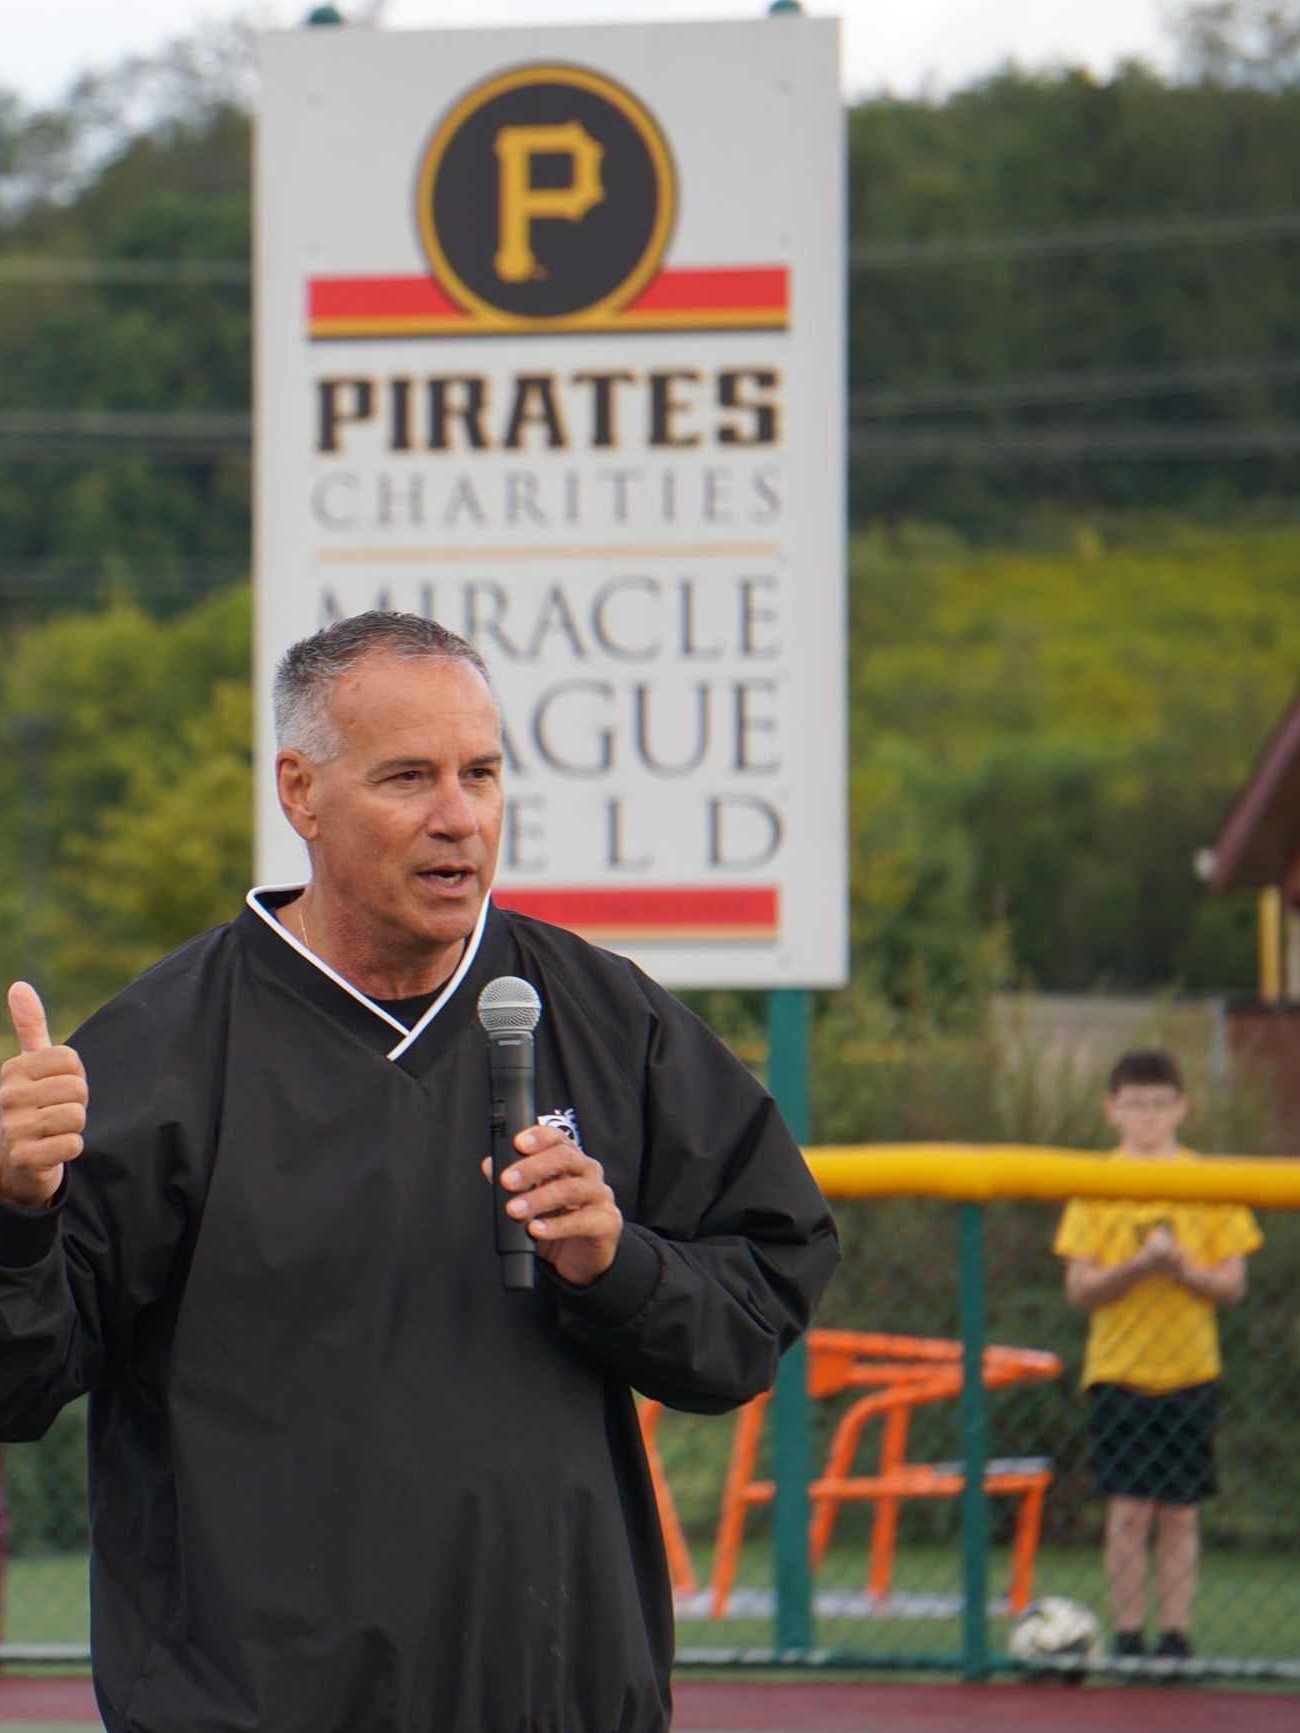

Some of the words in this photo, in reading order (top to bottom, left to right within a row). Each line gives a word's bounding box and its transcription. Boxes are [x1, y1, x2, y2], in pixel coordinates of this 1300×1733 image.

[313, 363, 786, 457] PIRATES
[309, 468, 784, 532] CHARITIES
[500, 676, 784, 780] GUE
[502, 791, 788, 873] ELD
